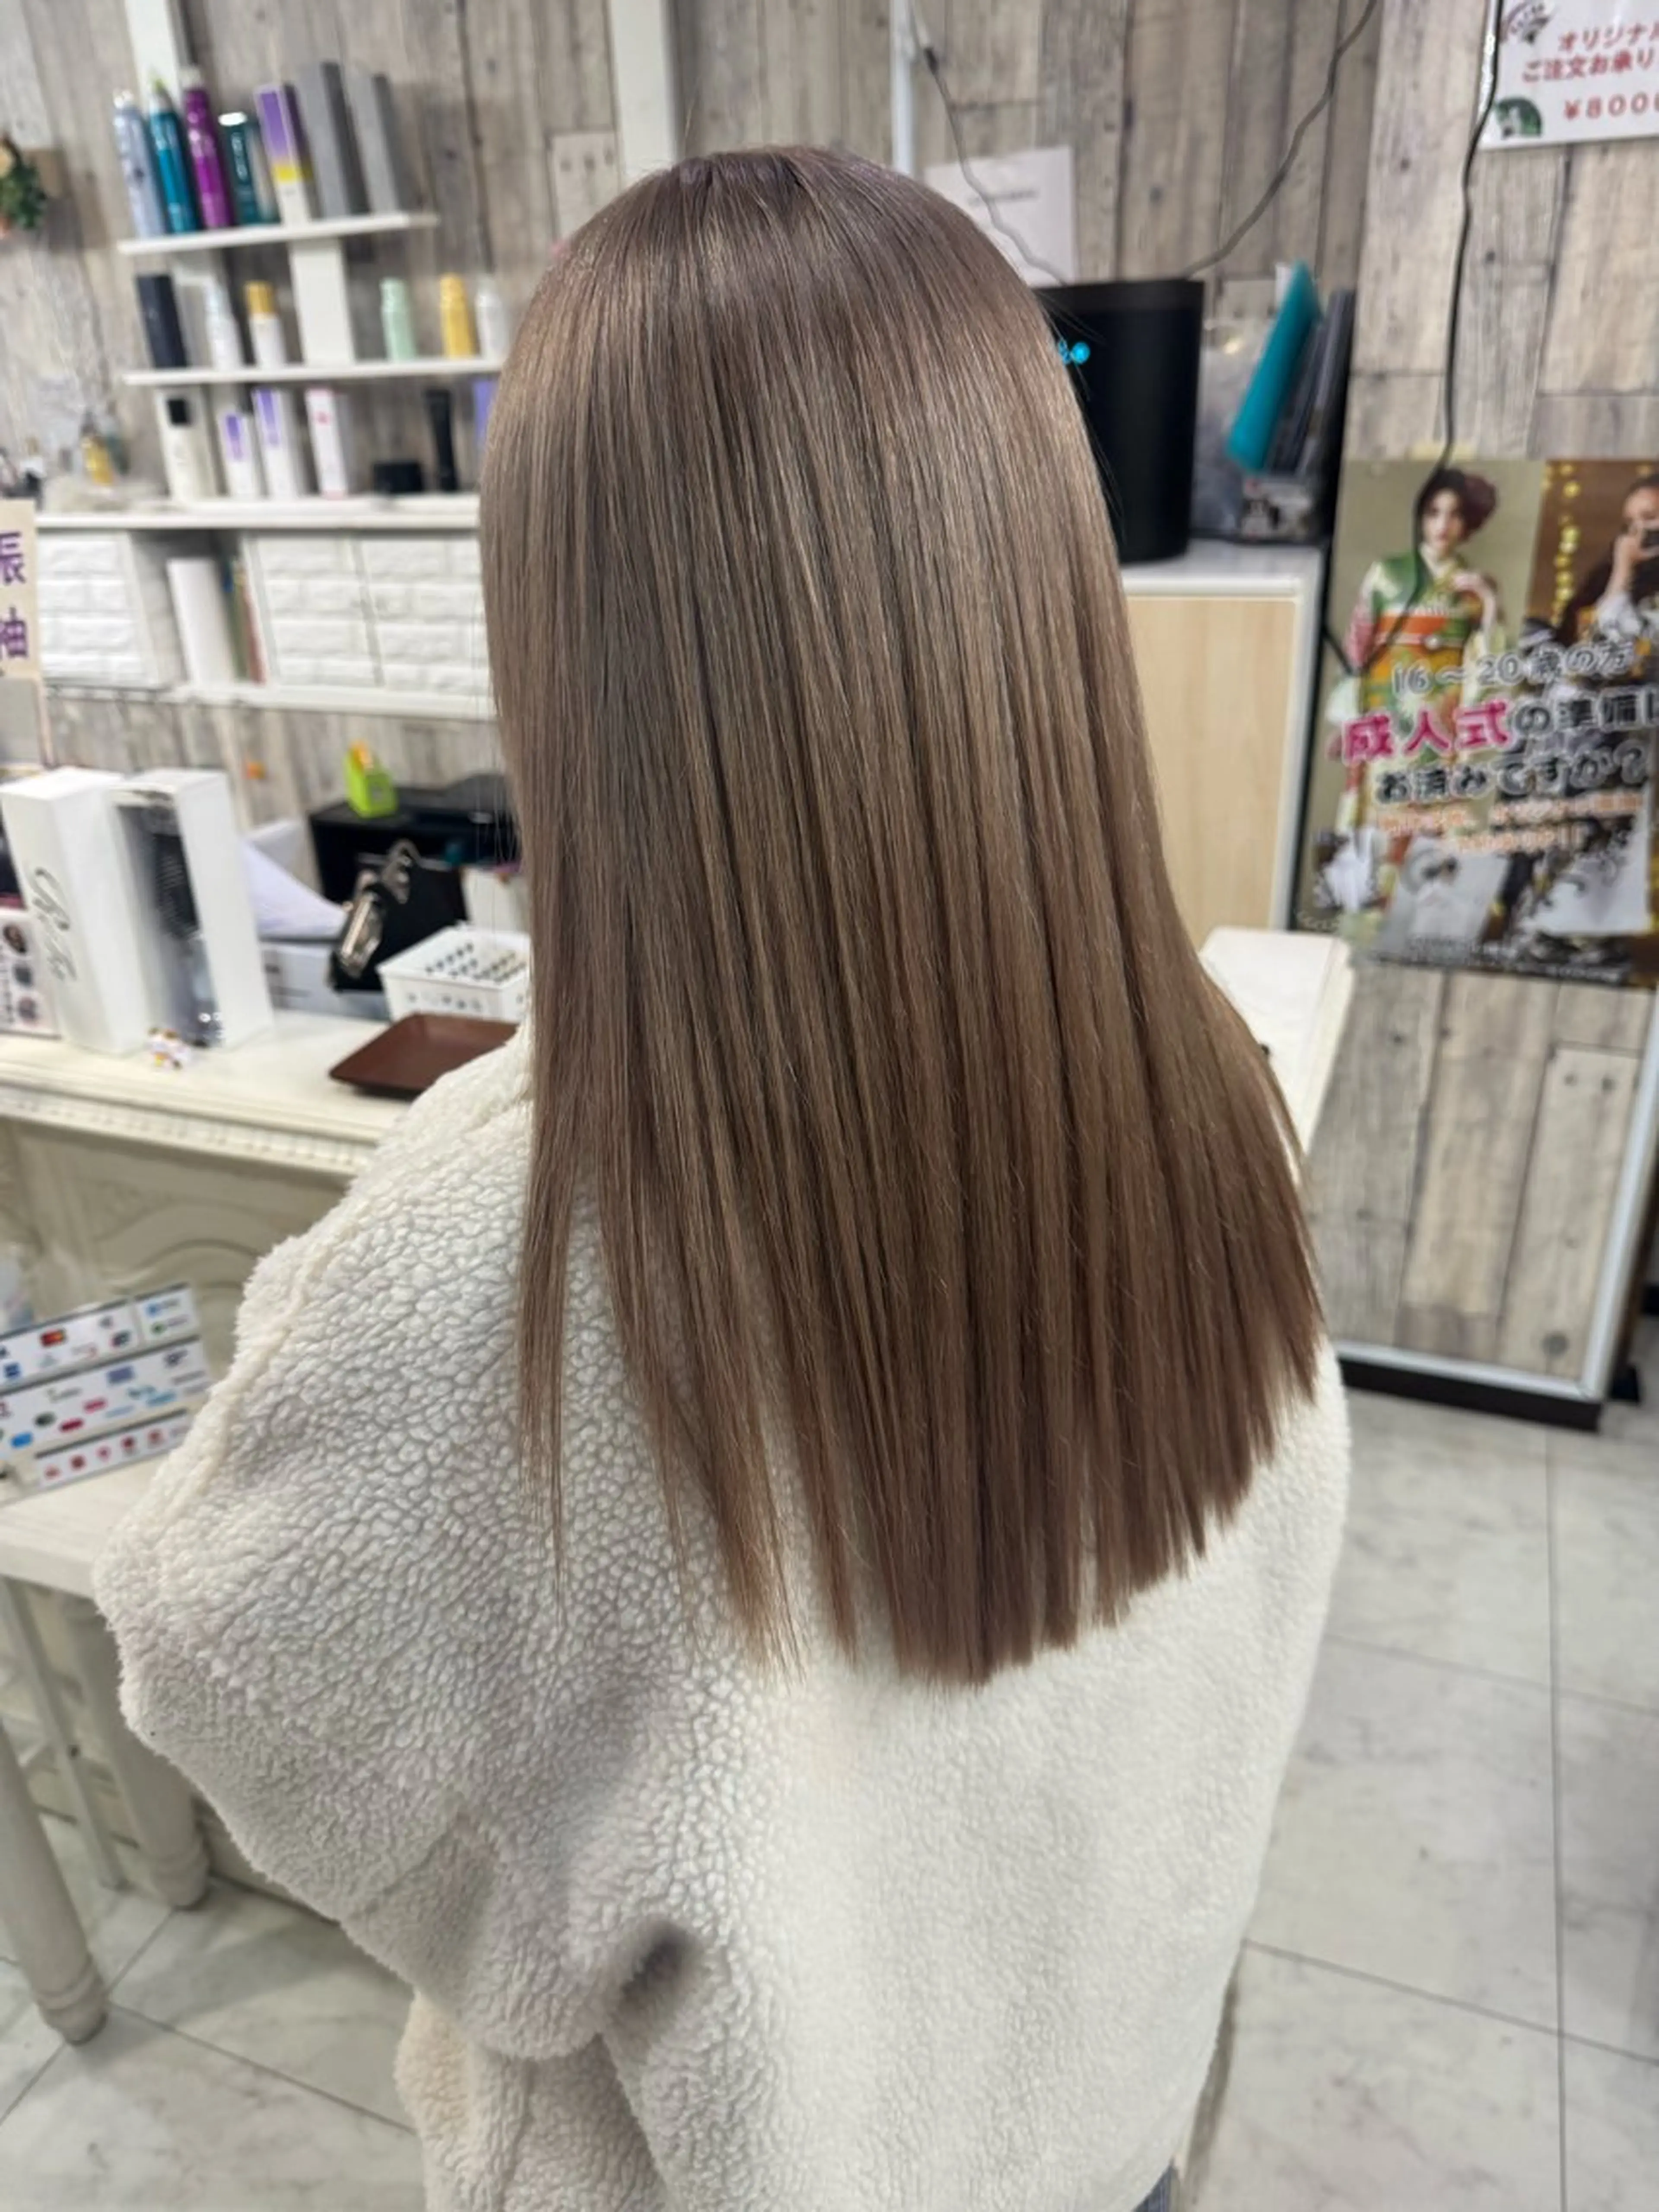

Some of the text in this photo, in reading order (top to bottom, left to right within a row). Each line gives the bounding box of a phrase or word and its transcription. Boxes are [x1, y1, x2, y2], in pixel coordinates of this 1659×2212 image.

[1564, 92, 1659, 120] ¥800
[1344, 690, 1659, 760] 成人式の準備
